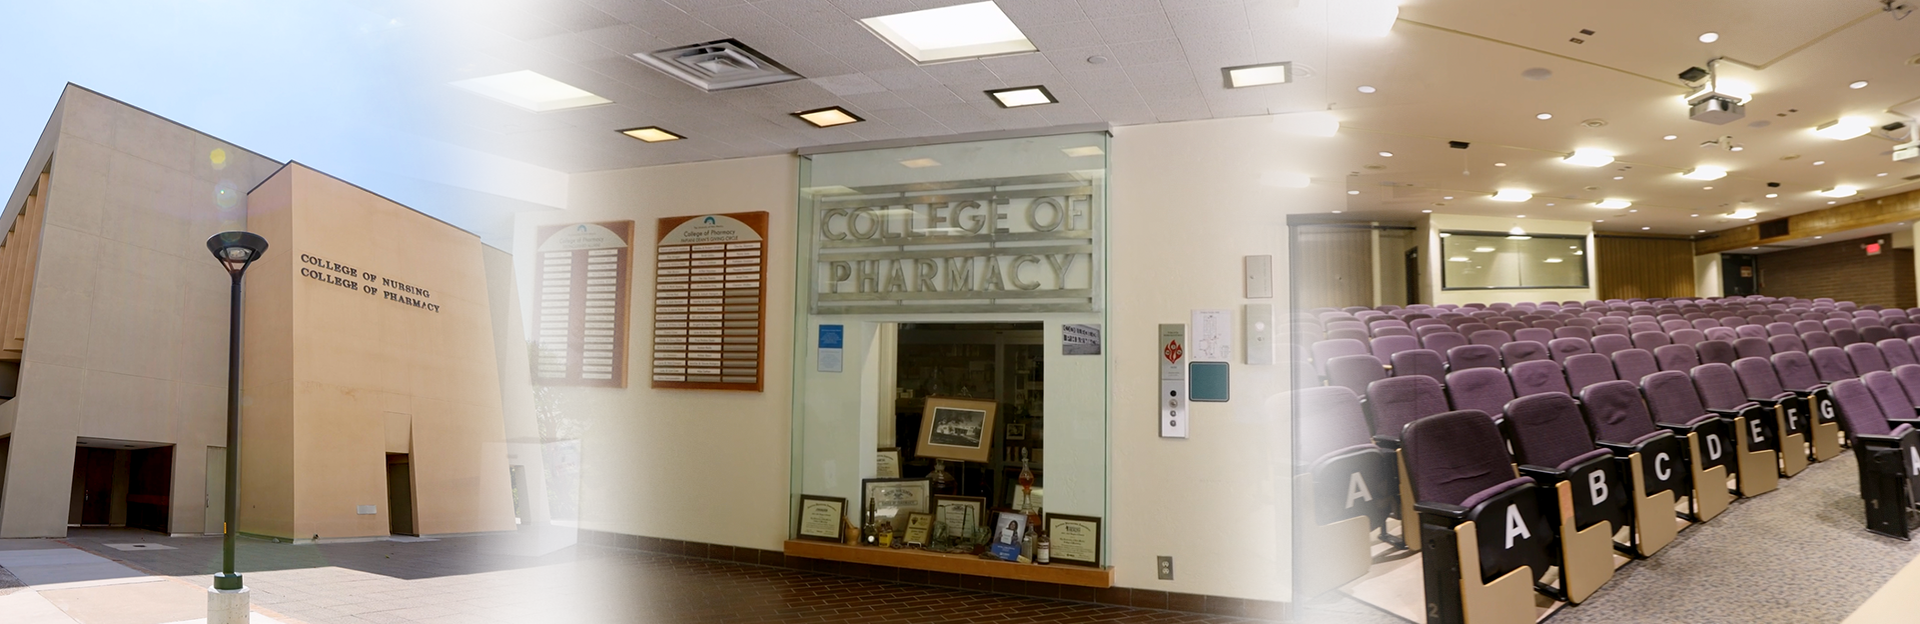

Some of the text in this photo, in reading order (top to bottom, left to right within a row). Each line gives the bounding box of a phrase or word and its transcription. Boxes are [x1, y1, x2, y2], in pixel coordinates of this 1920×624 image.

[821, 195, 1089, 242] COLLEGE OF
[300, 253, 430, 298] COLLEGE OF NURSING
[300, 267, 440, 313] COLLEGE OF PHARMACY
[830, 253, 1076, 294] PHARMACY
[1787, 408, 1799, 430] F
[1820, 399, 1834, 420] G
[1706, 433, 1722, 461] D
[1750, 419, 1765, 443] E
[1654, 452, 1671, 481] C
[1345, 471, 1373, 510] A
[1588, 469, 1608, 506] B
[1505, 503, 1531, 549] A
[1427, 603, 1439, 618] 2
